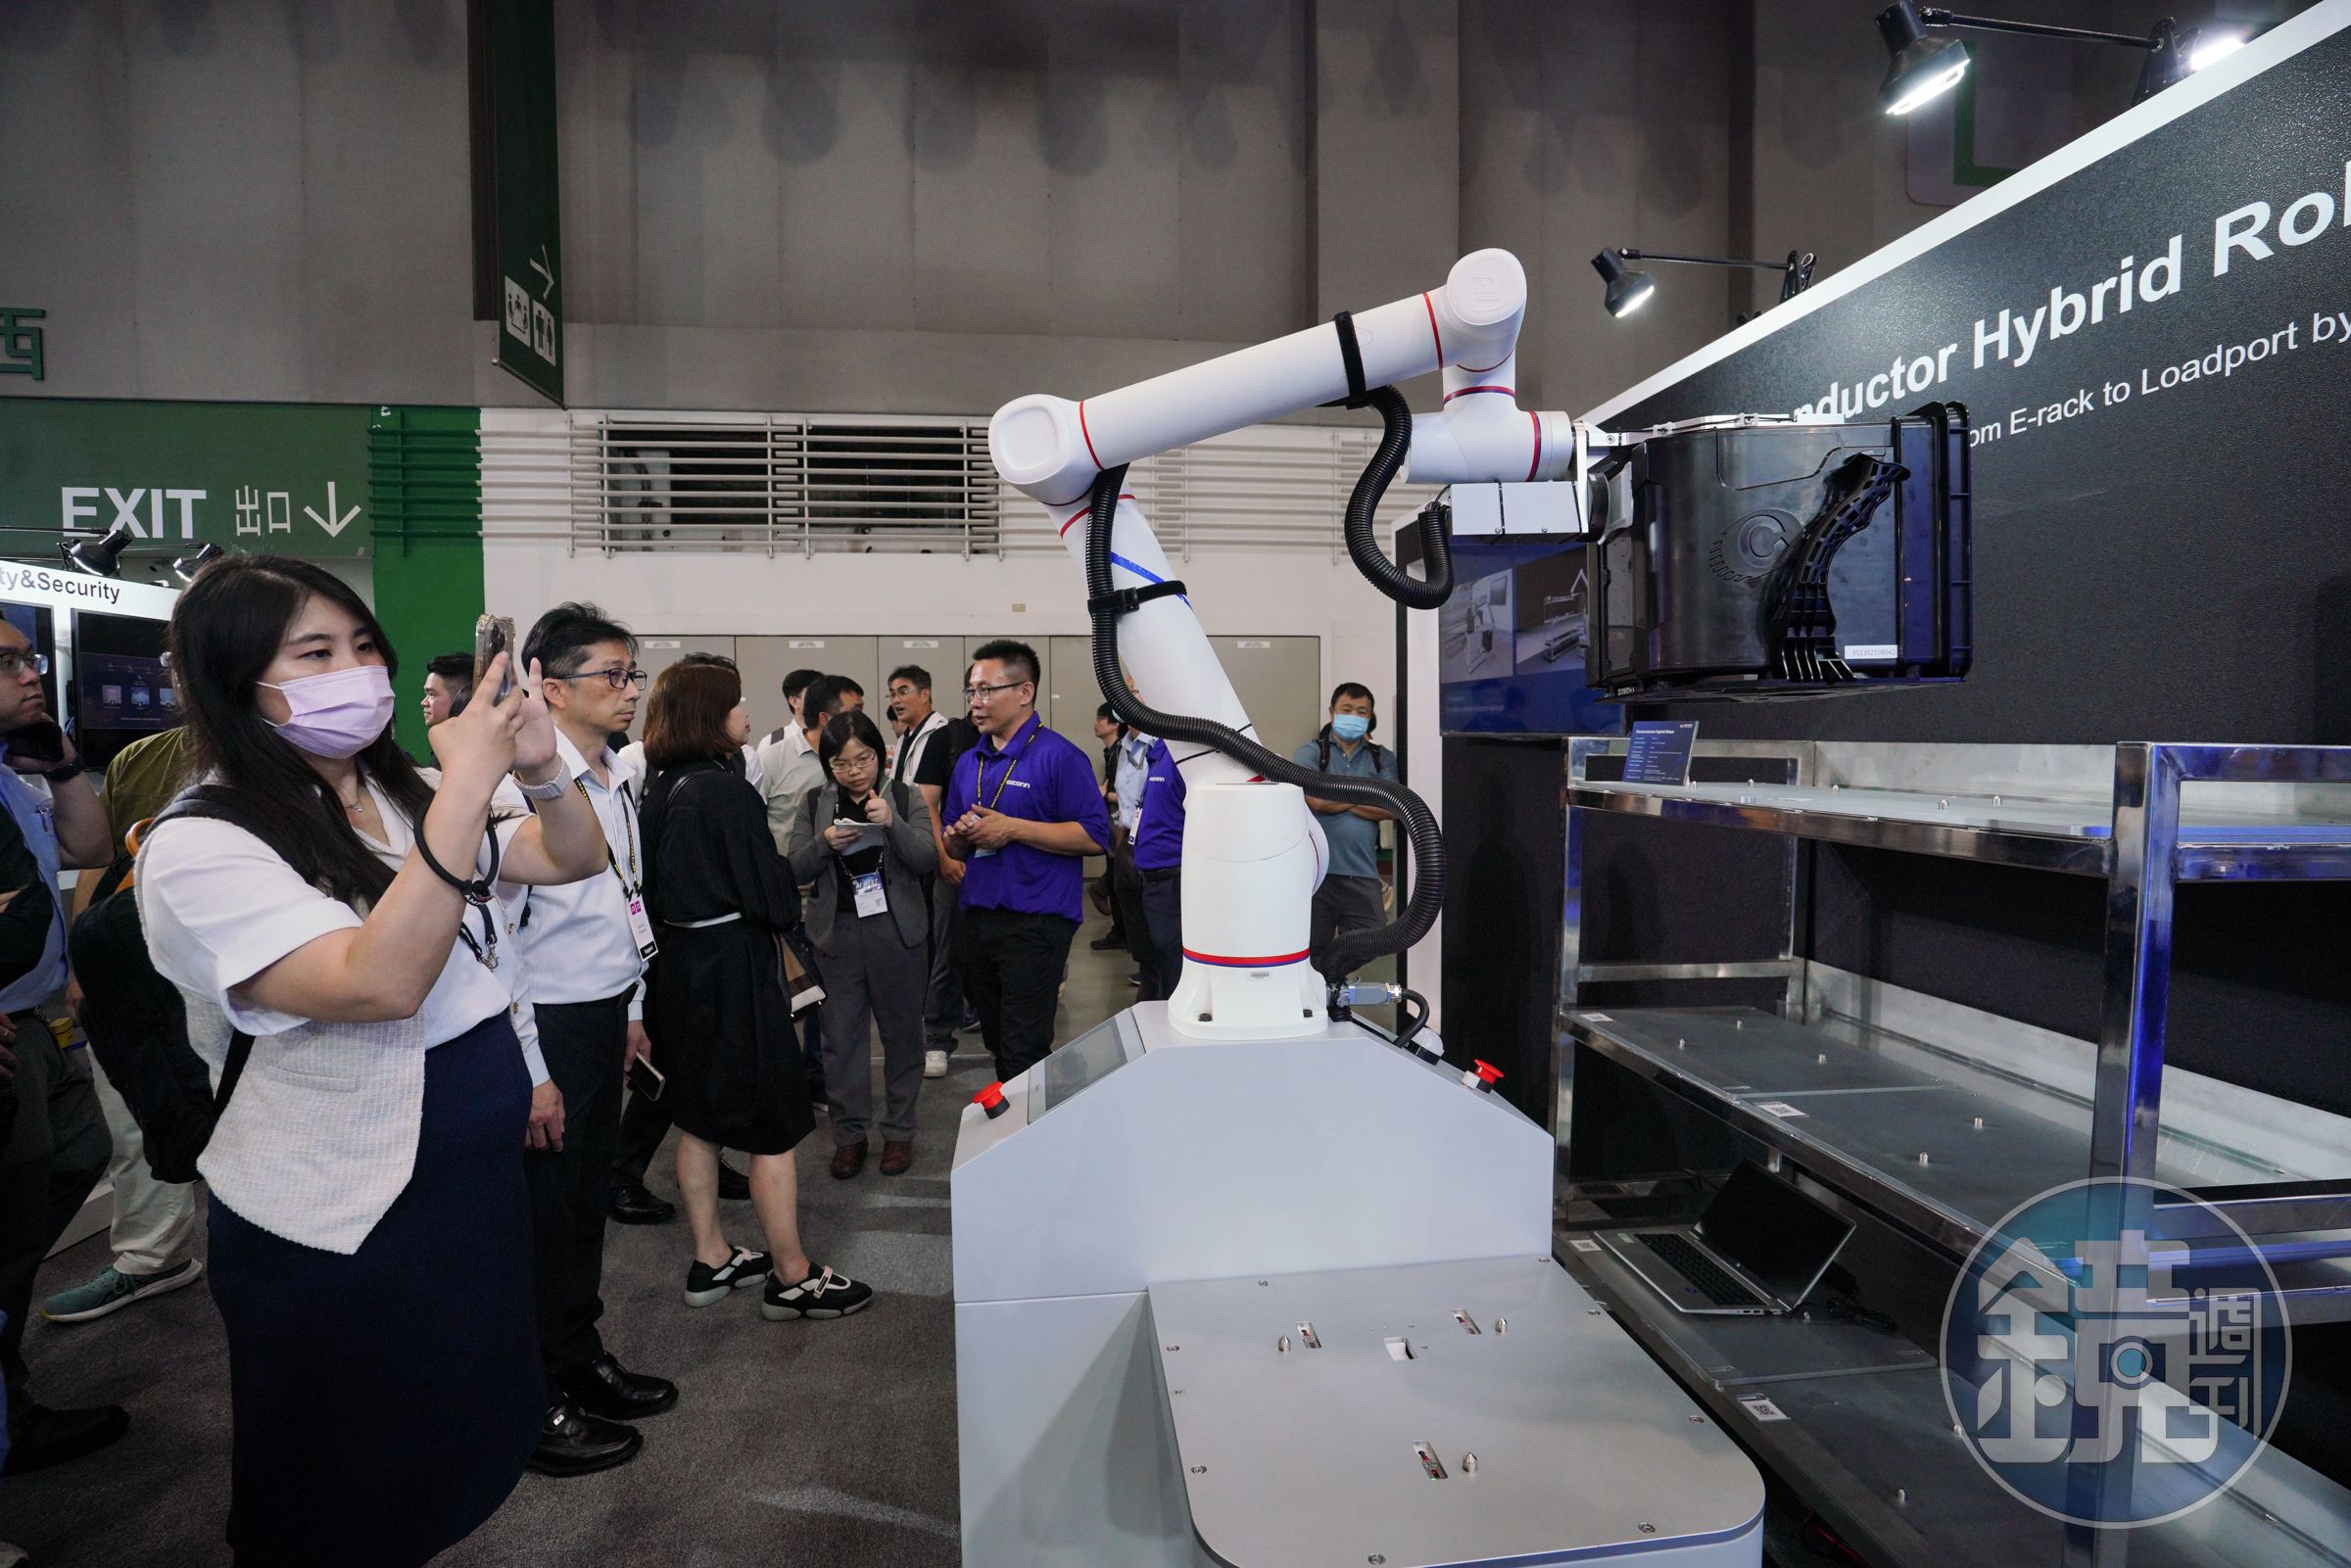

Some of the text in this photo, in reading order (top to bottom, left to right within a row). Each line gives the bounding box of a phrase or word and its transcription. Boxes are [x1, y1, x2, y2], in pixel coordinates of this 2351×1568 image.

[1794, 160, 2351, 418] ductor Hybrid Ro
[2009, 389, 2094, 435] E-rack
[2102, 381, 2131, 405] to
[2141, 321, 2299, 396] Loadport
[2312, 312, 2351, 343] by
[61, 487, 207, 539] EXIT
[235, 485, 291, 536] 出口
